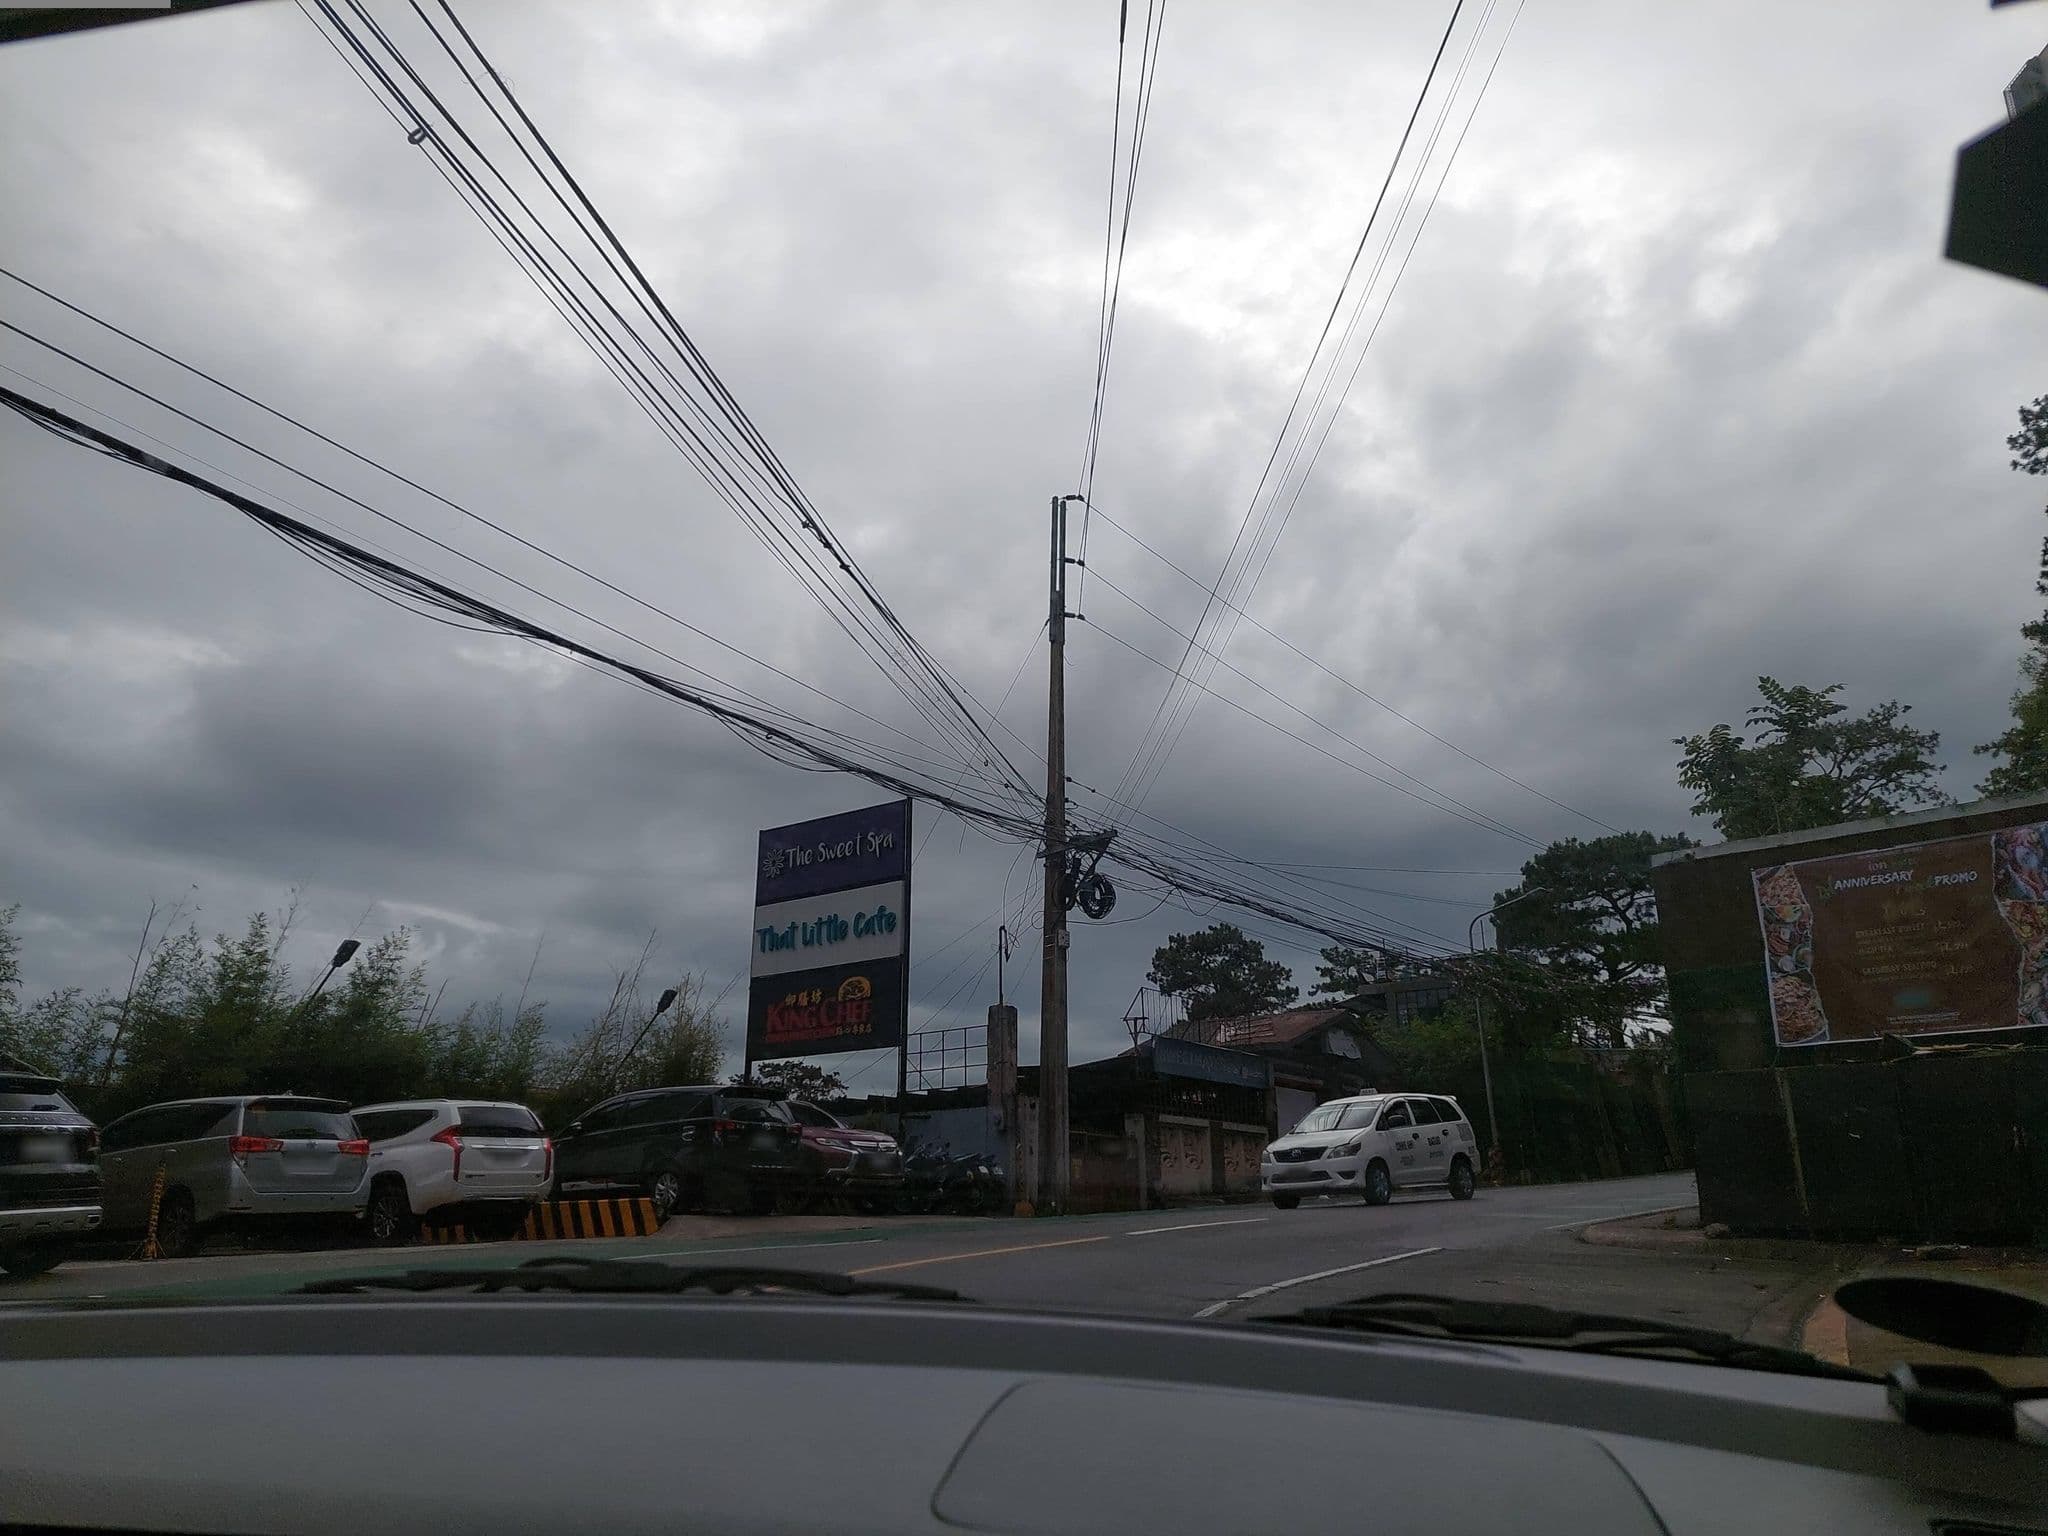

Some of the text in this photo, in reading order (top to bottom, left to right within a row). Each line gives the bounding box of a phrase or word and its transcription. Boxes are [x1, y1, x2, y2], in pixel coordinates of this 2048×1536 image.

[785, 831, 894, 868] The Sweet Spa
[1833, 870, 1979, 890] ANNIVERSARY PROMO
[756, 921, 799, 953] That
[802, 913, 848, 947] Little
